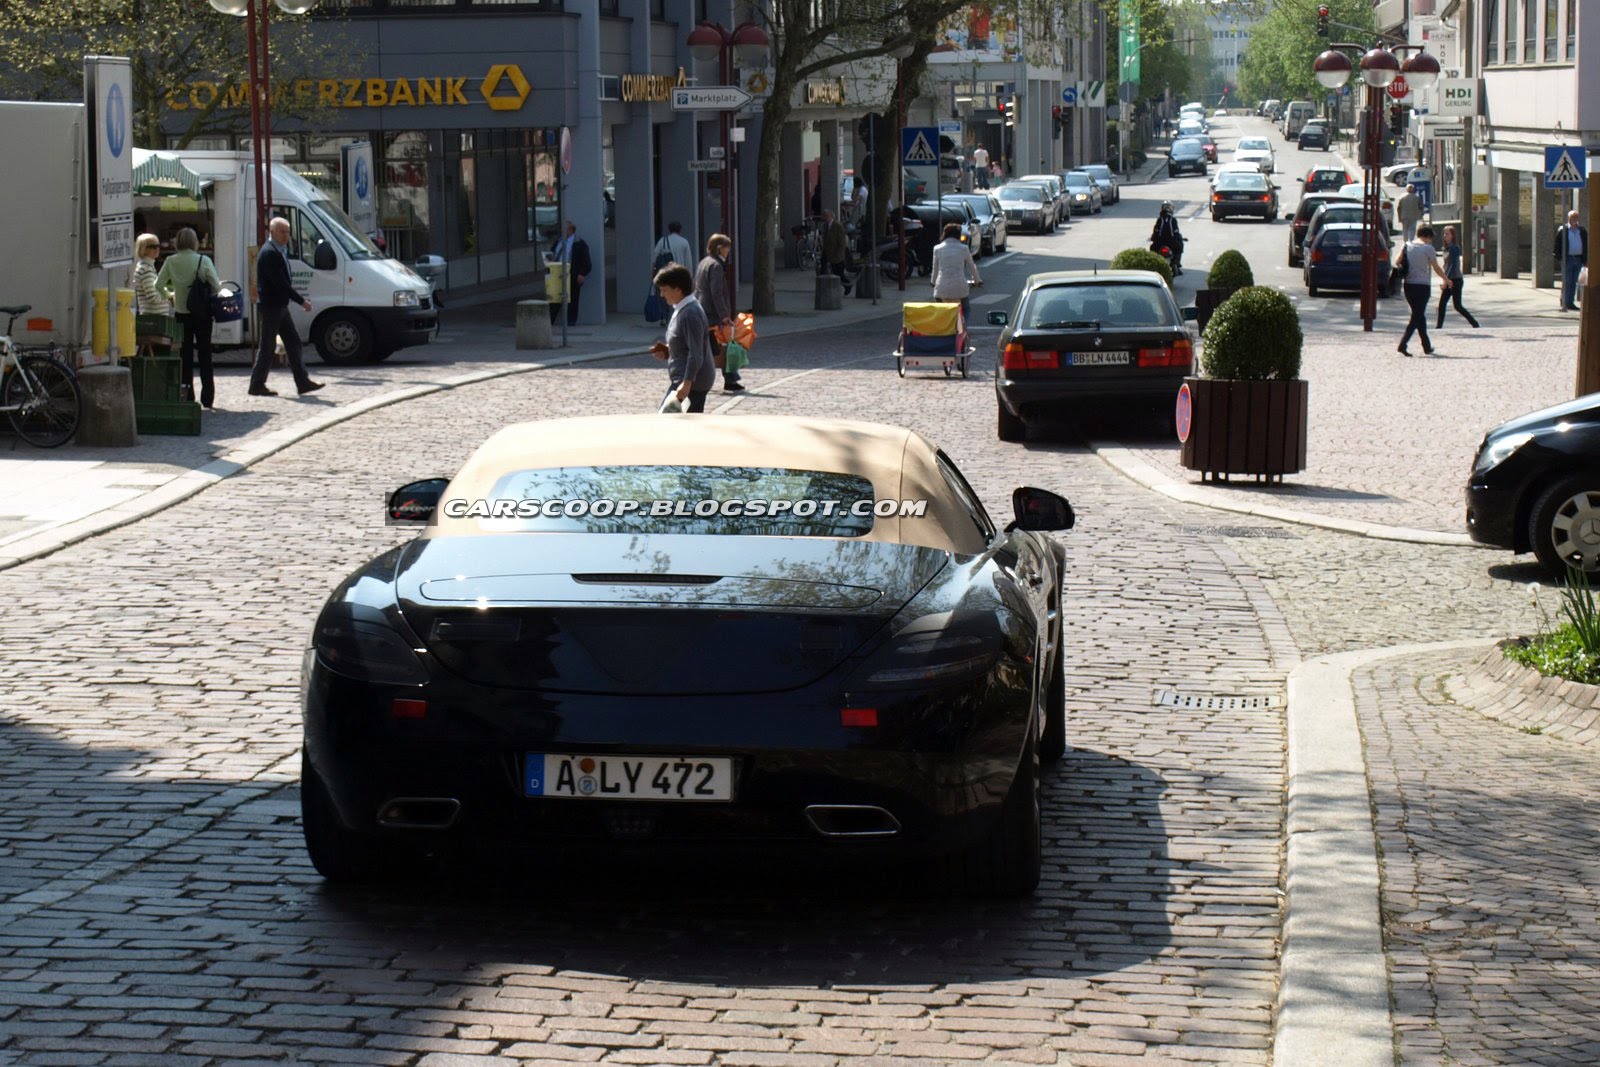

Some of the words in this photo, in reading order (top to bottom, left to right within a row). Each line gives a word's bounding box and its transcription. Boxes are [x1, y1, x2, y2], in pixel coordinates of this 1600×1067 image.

[1445, 88, 1472, 98] HDI
[690, 94, 737, 104] Marktplatz
[1073, 353, 1086, 364] BB
[1105, 351, 1128, 364] 4444
[556, 760, 576, 793] A
[601, 761, 643, 794] LY
[652, 762, 715, 795] 472
[531, 778, 539, 789] D
